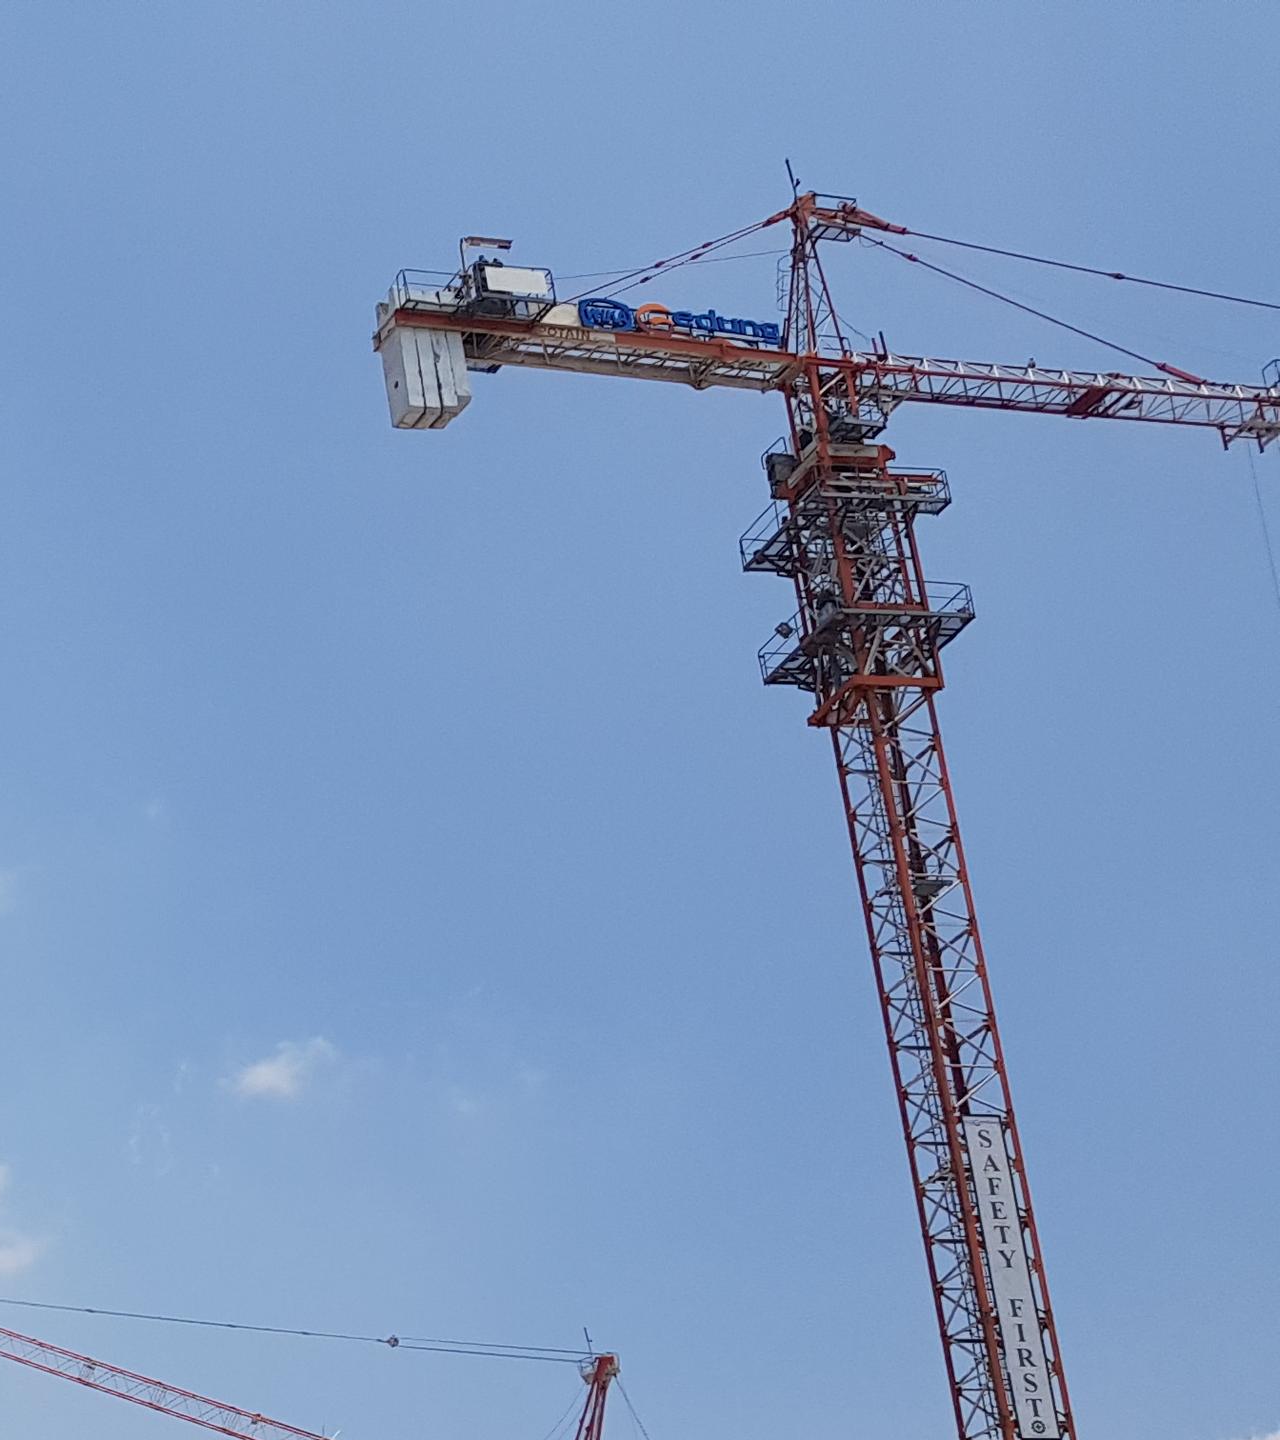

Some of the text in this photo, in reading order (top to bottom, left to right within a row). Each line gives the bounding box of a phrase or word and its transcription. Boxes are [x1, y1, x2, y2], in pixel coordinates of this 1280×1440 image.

[636, 303, 779, 344] Gedung
[976, 1128, 1016, 1269] SAFETY
[1008, 1298, 1044, 1418] FIRST
